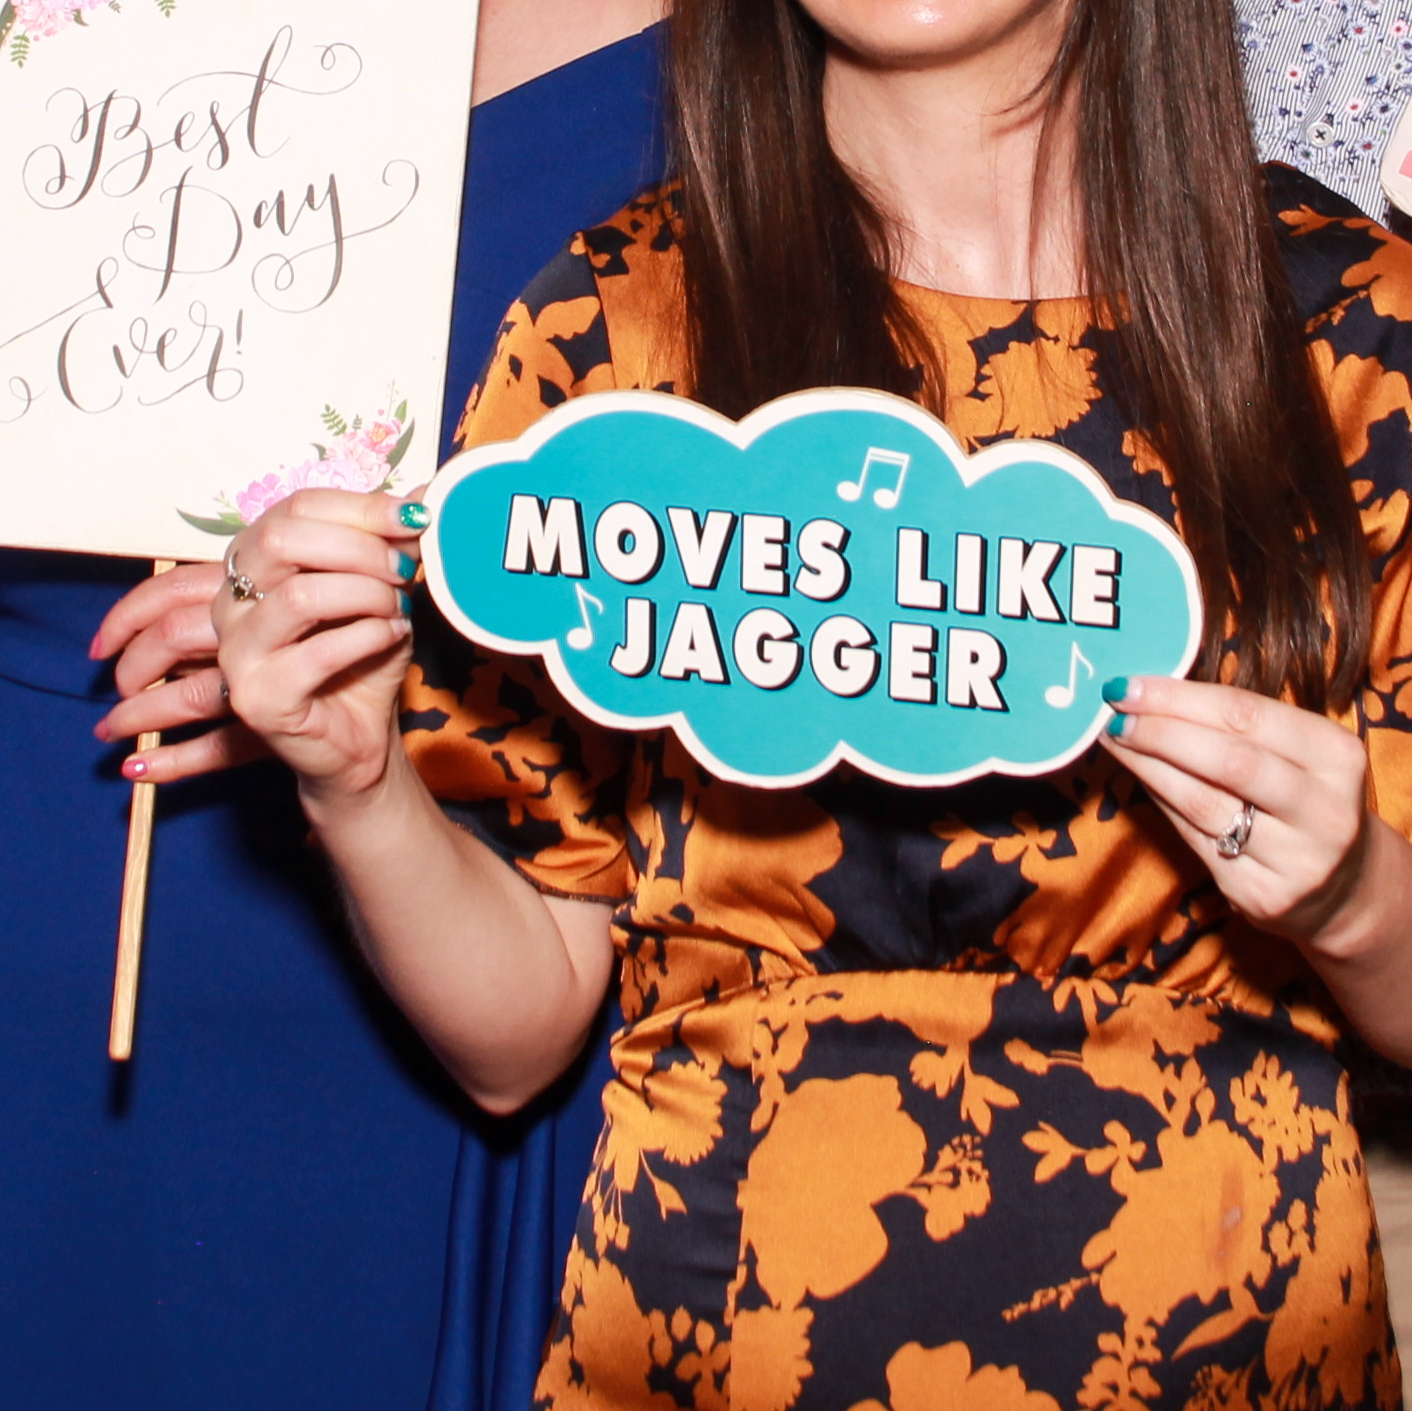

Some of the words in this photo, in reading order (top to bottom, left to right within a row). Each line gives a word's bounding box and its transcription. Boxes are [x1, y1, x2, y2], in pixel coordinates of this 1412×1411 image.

[23, 25, 362, 210] Best
[123, 159, 420, 313] Day
[503, 493, 852, 601] MOVES
[893, 526, 1121, 629] LIKE
[609, 597, 1009, 712] JAGGER
